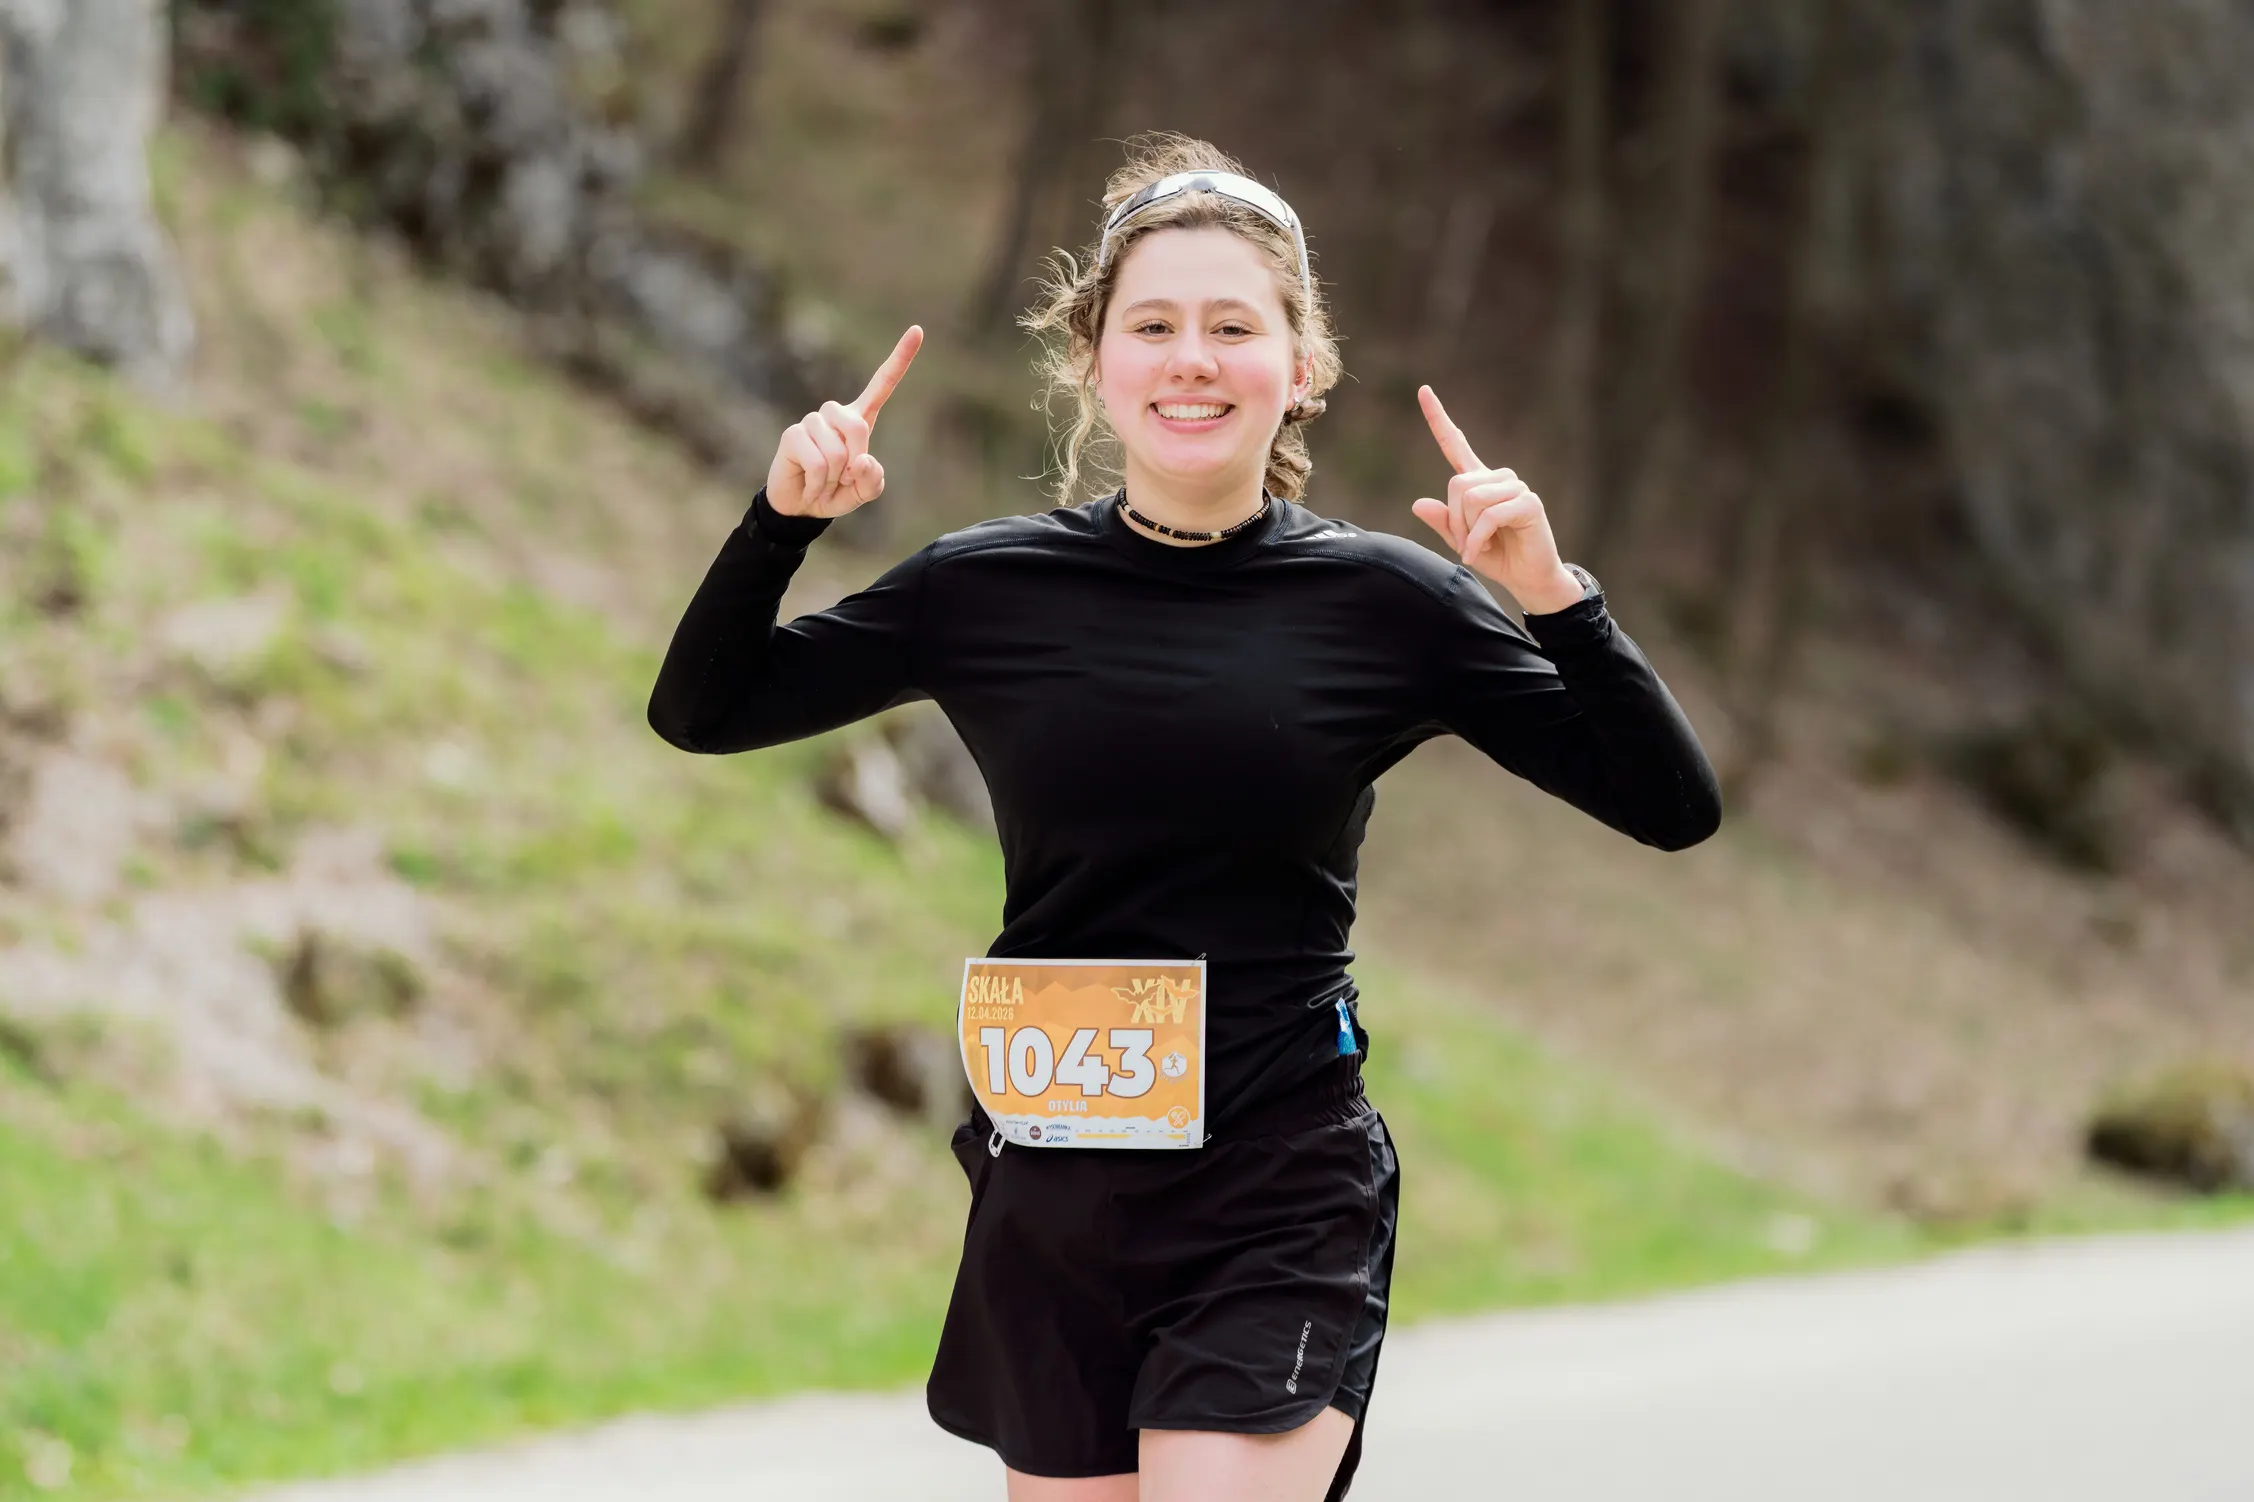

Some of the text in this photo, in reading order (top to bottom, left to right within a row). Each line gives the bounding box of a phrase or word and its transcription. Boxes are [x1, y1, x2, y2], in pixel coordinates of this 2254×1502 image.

[968, 975, 1024, 1005] SKAŁA
[1130, 978, 1192, 1024] XIV
[967, 1006, 1014, 1021] 12.04.2026
[979, 1025, 1157, 1098] 1043
[1048, 1100, 1088, 1112] OTYLIA
